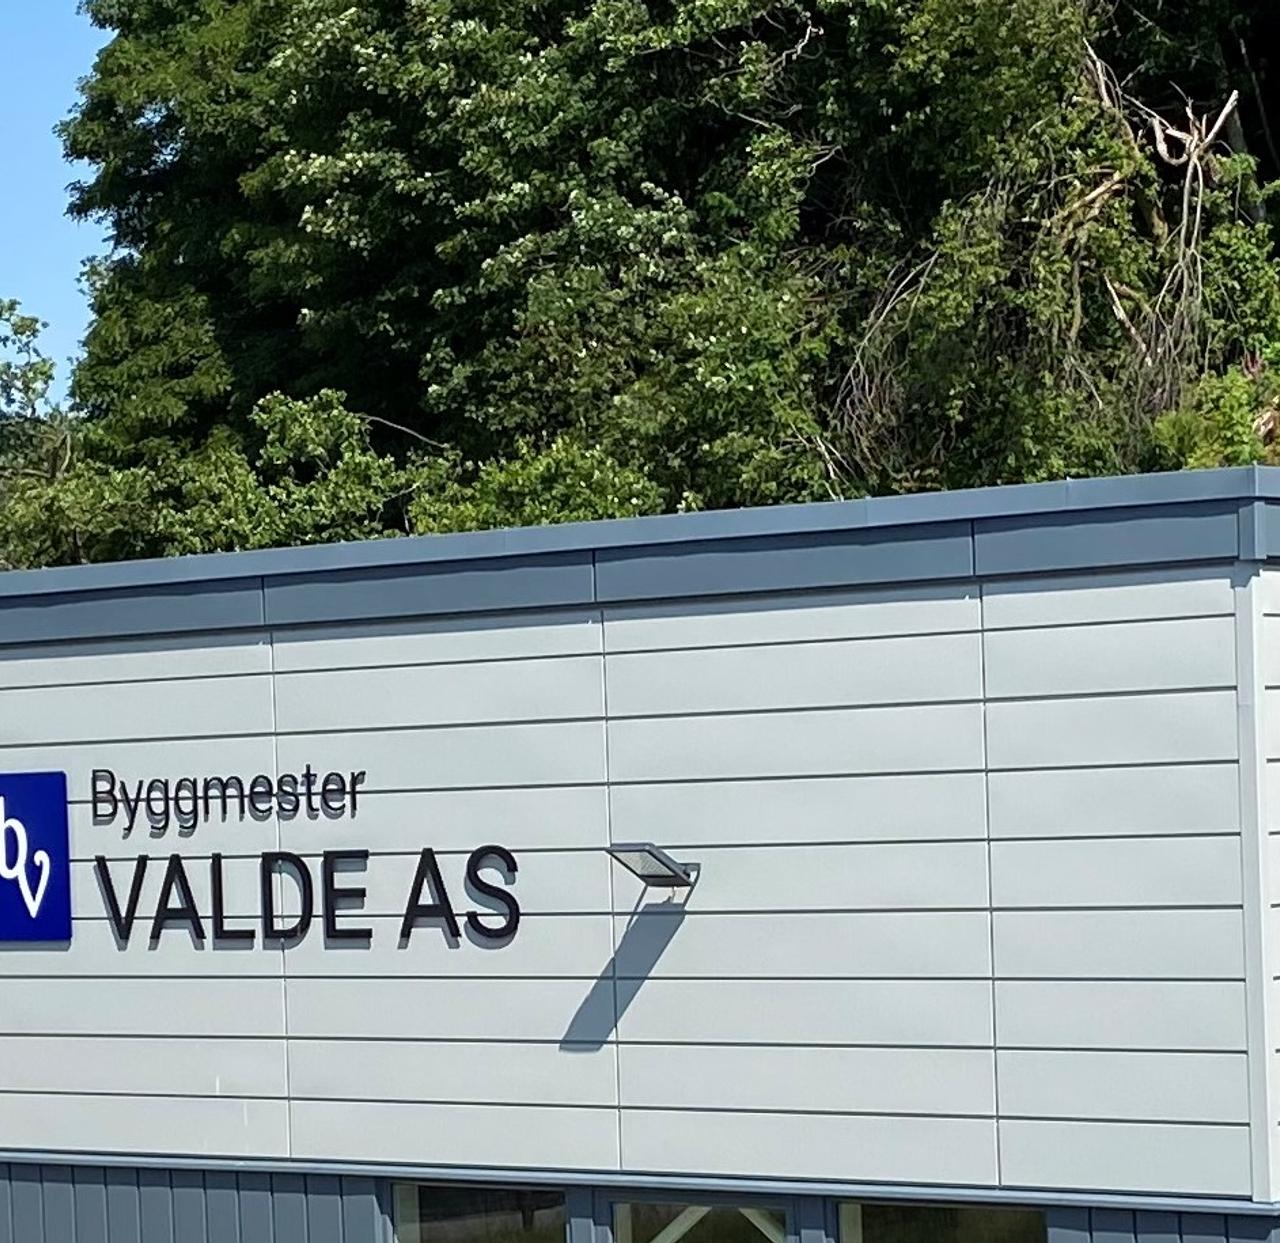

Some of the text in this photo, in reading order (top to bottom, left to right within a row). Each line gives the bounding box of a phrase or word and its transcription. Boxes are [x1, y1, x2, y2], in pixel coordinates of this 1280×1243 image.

[91, 764, 367, 833] Byggmester
[94, 844, 520, 941] VALDE AS
